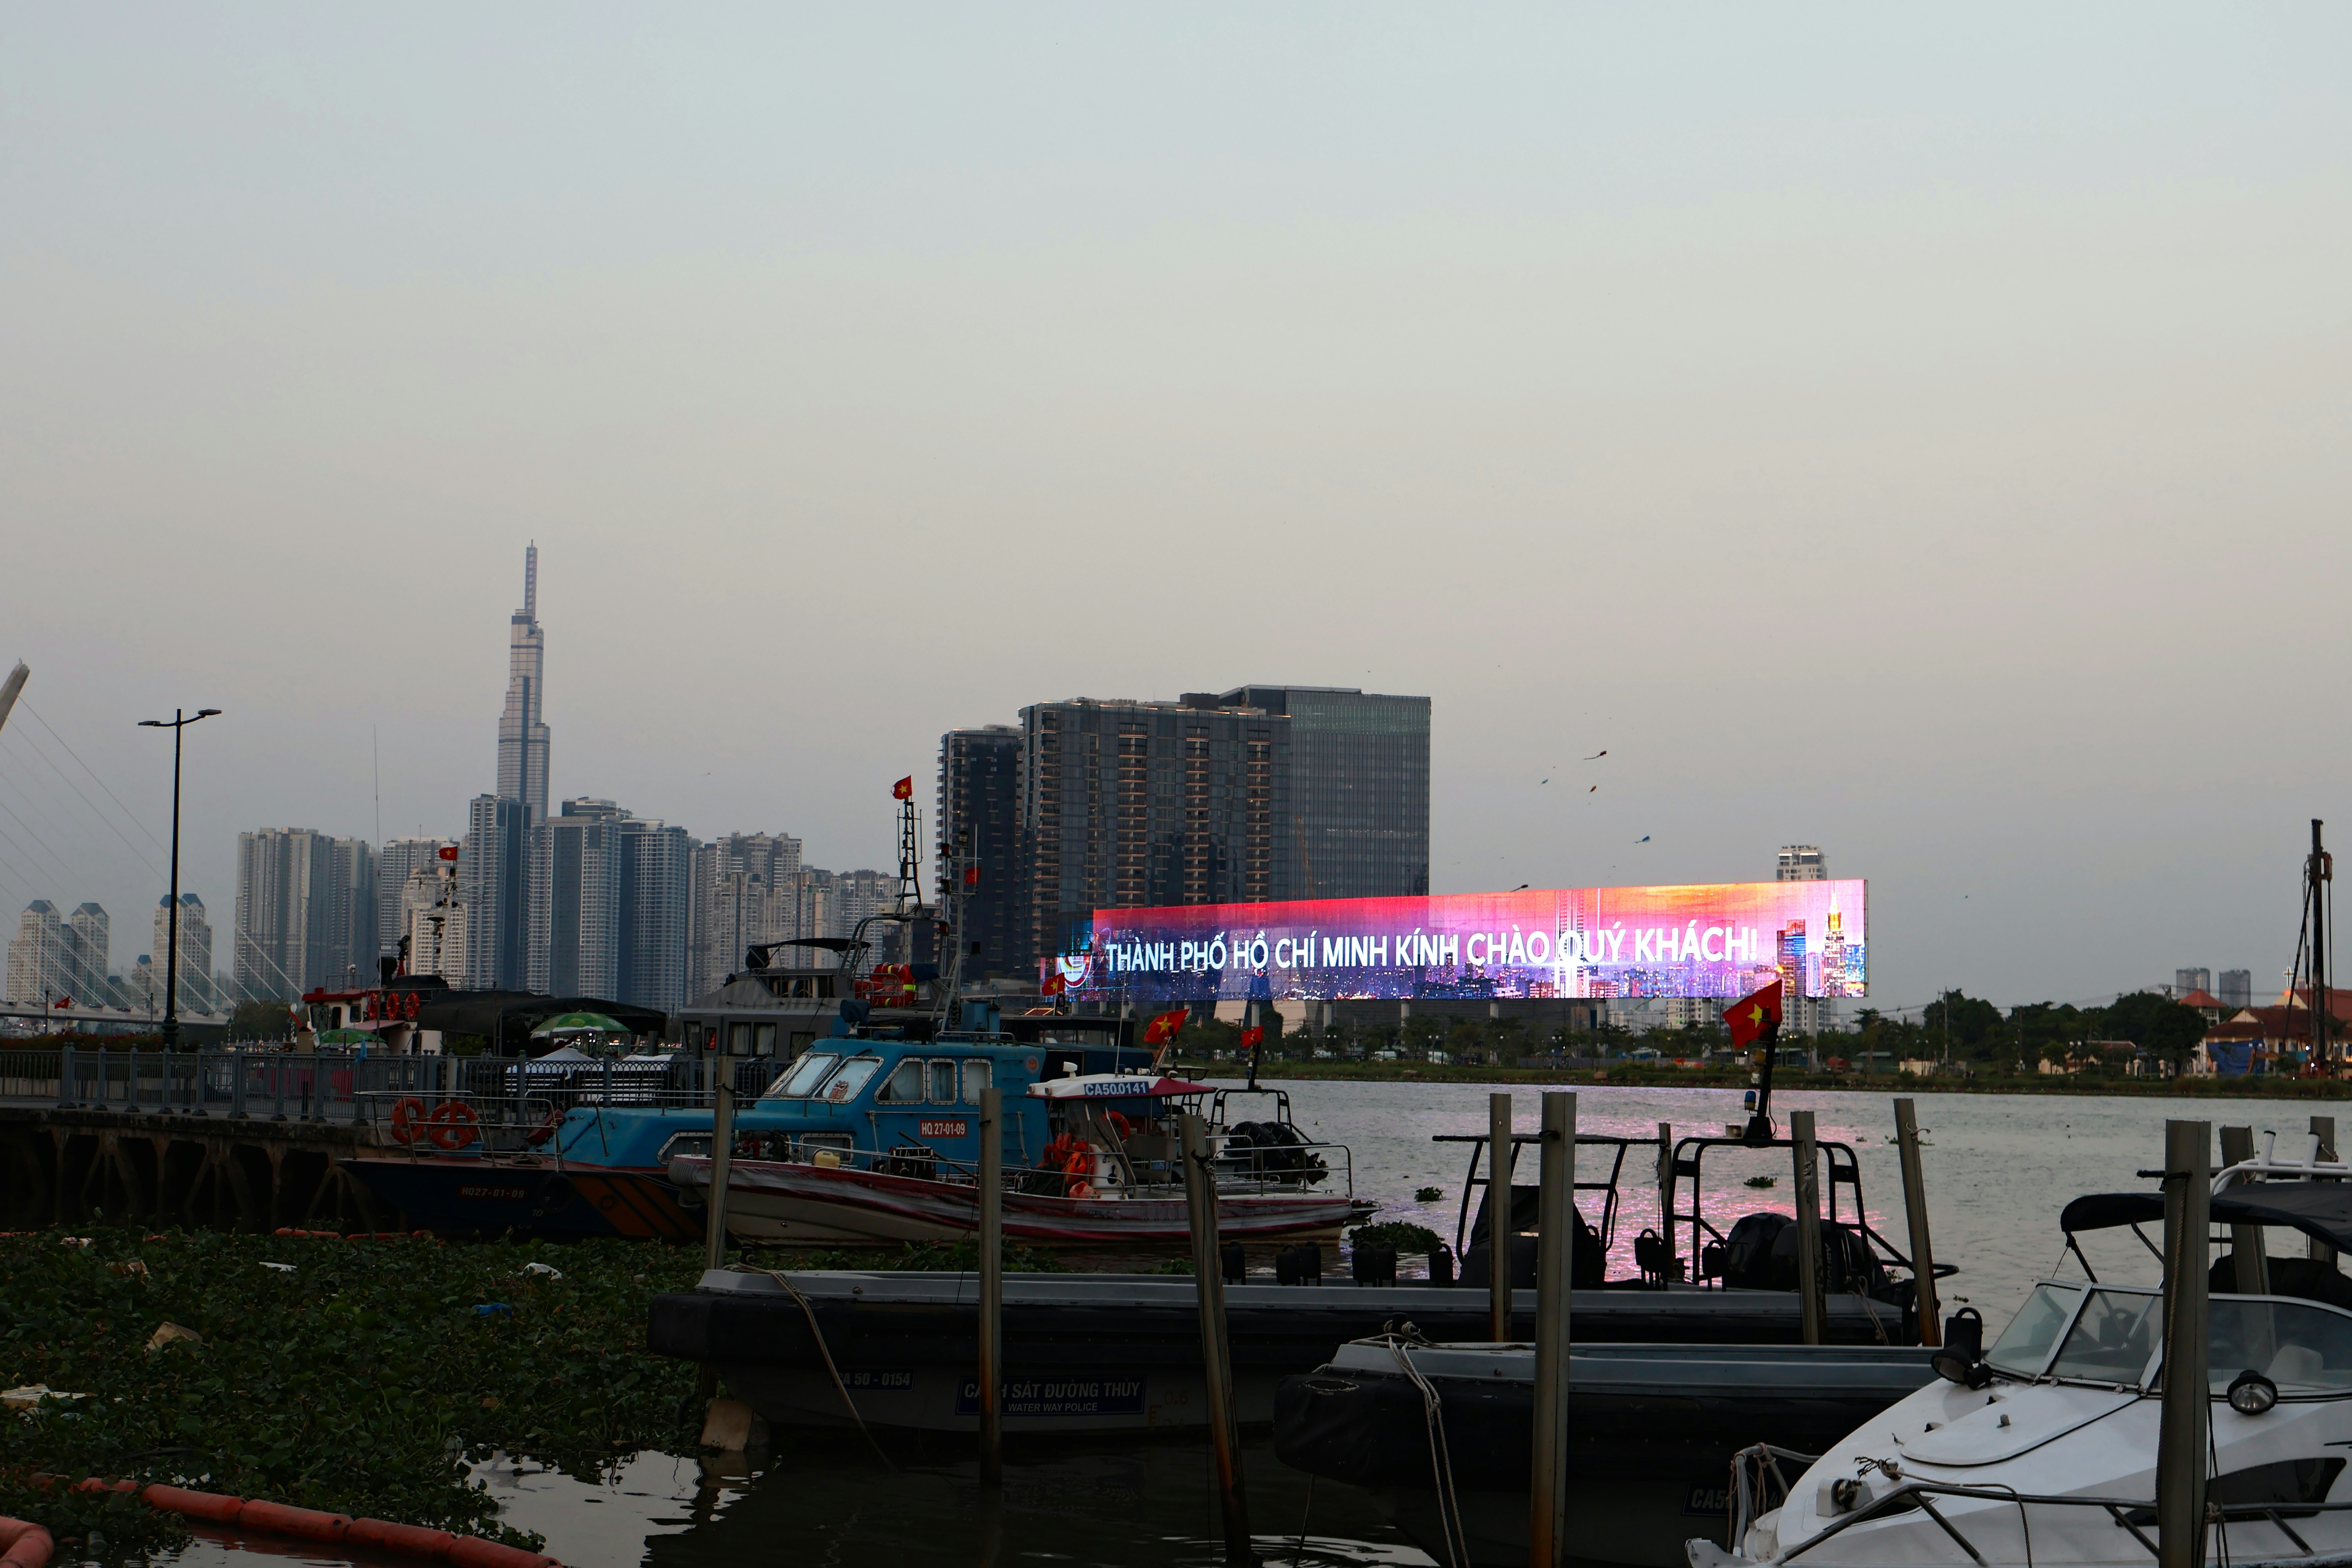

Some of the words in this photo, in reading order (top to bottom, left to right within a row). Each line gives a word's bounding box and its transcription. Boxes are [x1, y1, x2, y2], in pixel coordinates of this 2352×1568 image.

[1106, 937, 1174, 971] THÀNH
[1181, 931, 1227, 970] PHỐ
[1234, 930, 1269, 969] HỒ
[1275, 930, 1317, 968] CHÍ
[1323, 936, 1387, 967] MINH
[1396, 927, 1458, 966] KÍNH
[1467, 924, 1550, 965] CHÀO
[1558, 922, 1626, 964] QUÝ
[1635, 919, 1757, 962] KHÁCH!
[1085, 1082, 1146, 1096] CA50.0141
[922, 1122, 933, 1135] HQ
[935, 1123, 965, 1135] 27-01-09
[462, 1187, 524, 1198] HQ27-01-09
[854, 1373, 870, 1385] 50
[882, 1373, 911, 1386] 0154
[1011, 1380, 1041, 1398] SÁT
[1044, 1379, 1099, 1398] ĐƯỜNG
[1103, 1377, 1141, 1397] THỦY
[1008, 1403, 1040, 1412] WATER
[1043, 1403, 1063, 1412] WAY
[1065, 1402, 1098, 1412] POLICE
